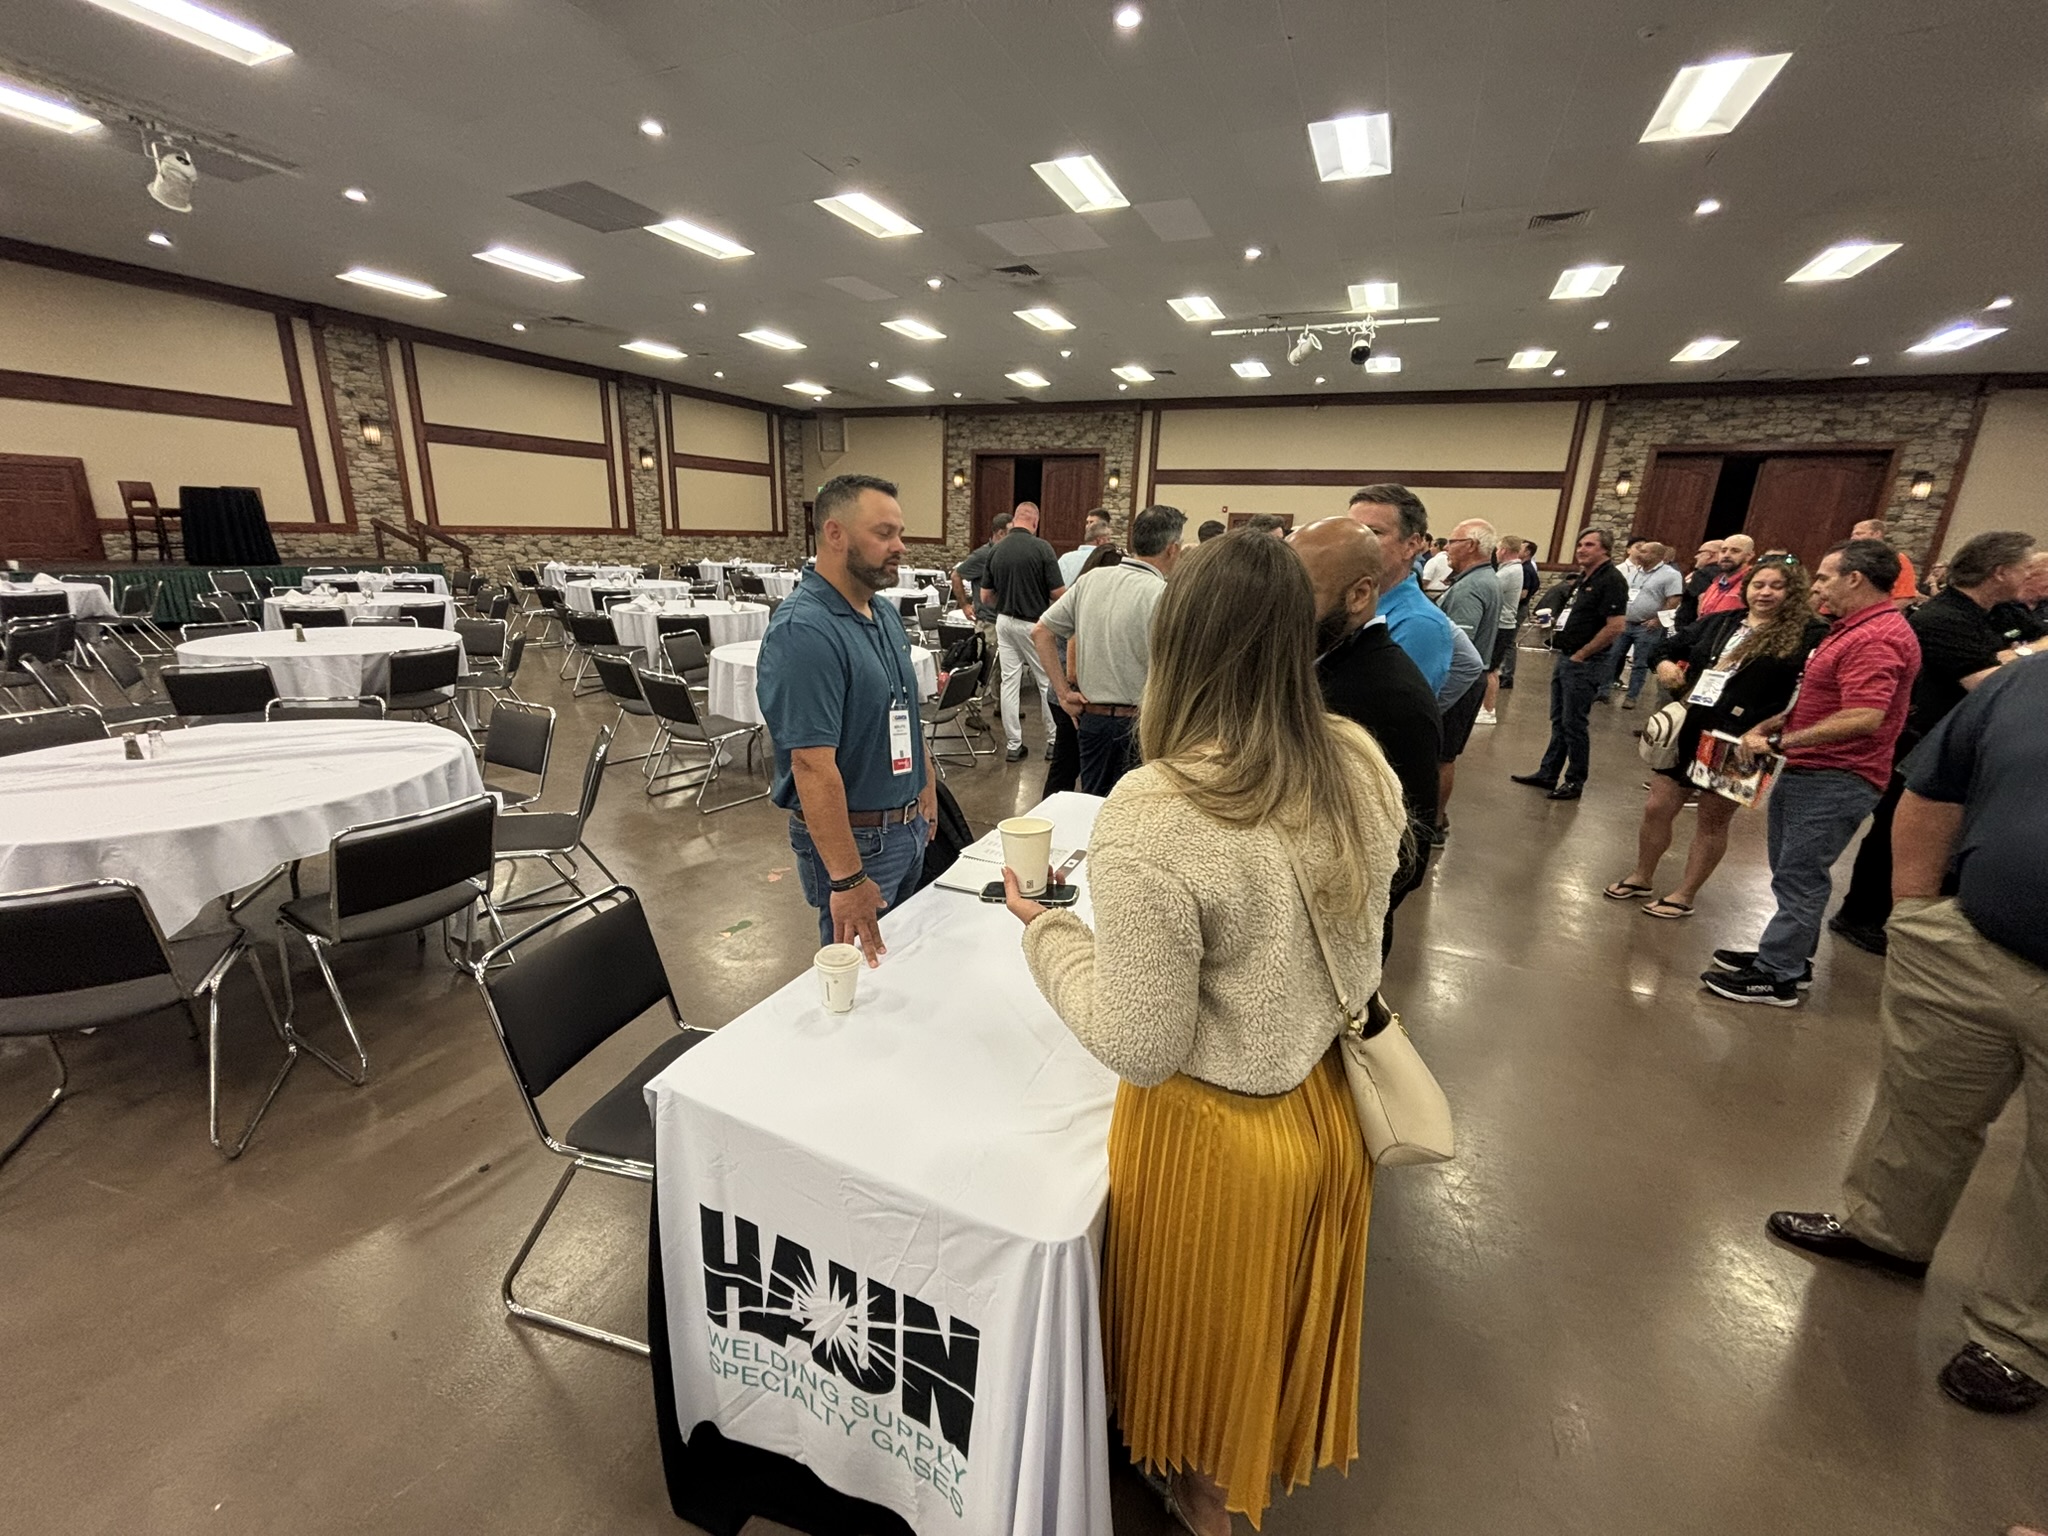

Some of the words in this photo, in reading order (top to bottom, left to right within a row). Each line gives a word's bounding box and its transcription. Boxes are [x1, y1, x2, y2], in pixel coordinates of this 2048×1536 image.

[1746, 985, 1774, 993] HOKA
[699, 1202, 980, 1461] HAUN
[708, 1325, 839, 1406] WELDING
[851, 1395, 967, 1485] SUPPLY
[709, 1351, 857, 1436] SPECIALTY
[871, 1430, 963, 1518] GASES
